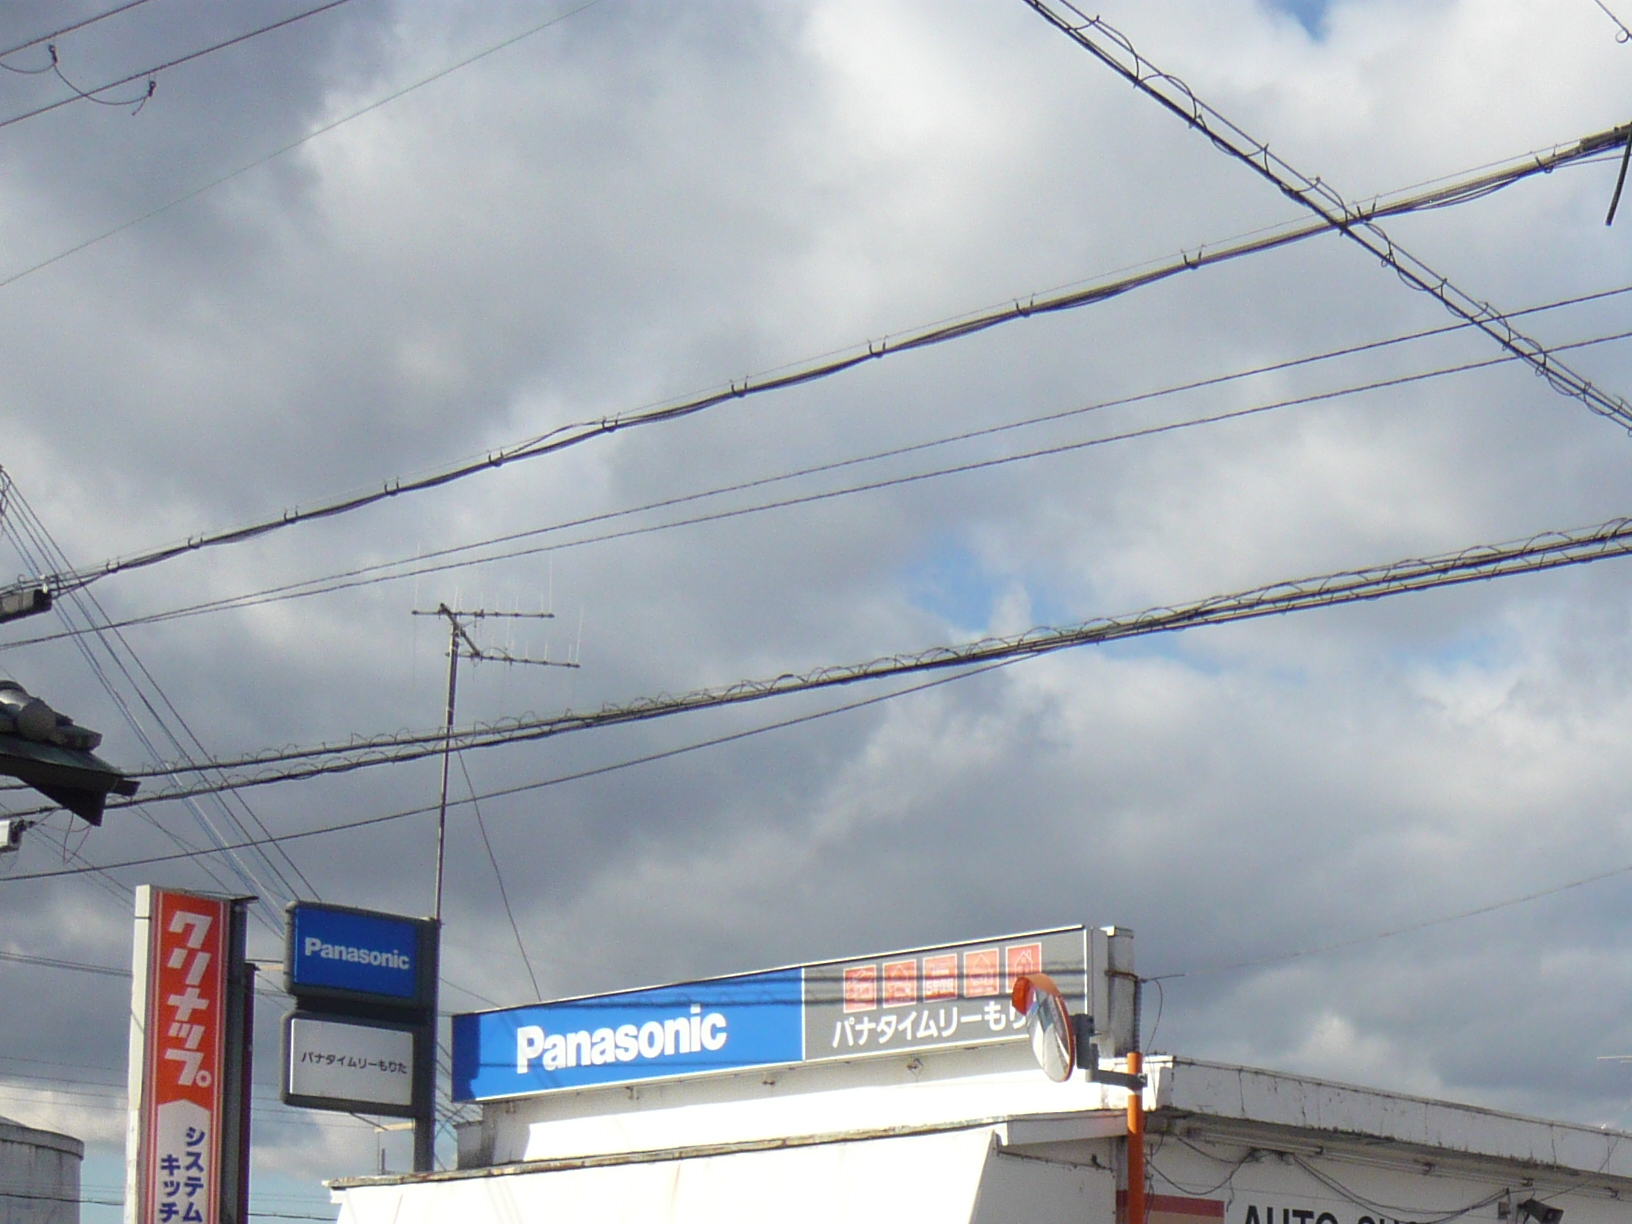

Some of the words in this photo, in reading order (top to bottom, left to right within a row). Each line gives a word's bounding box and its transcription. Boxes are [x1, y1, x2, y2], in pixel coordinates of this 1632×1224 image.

[304, 937, 410, 970] Panasonic
[164, 910, 213, 1087] クリナップ
[301, 1051, 408, 1075] パナタイムリーもりた
[516, 1003, 728, 1074] Panasonic
[182, 1126, 206, 1224] システム
